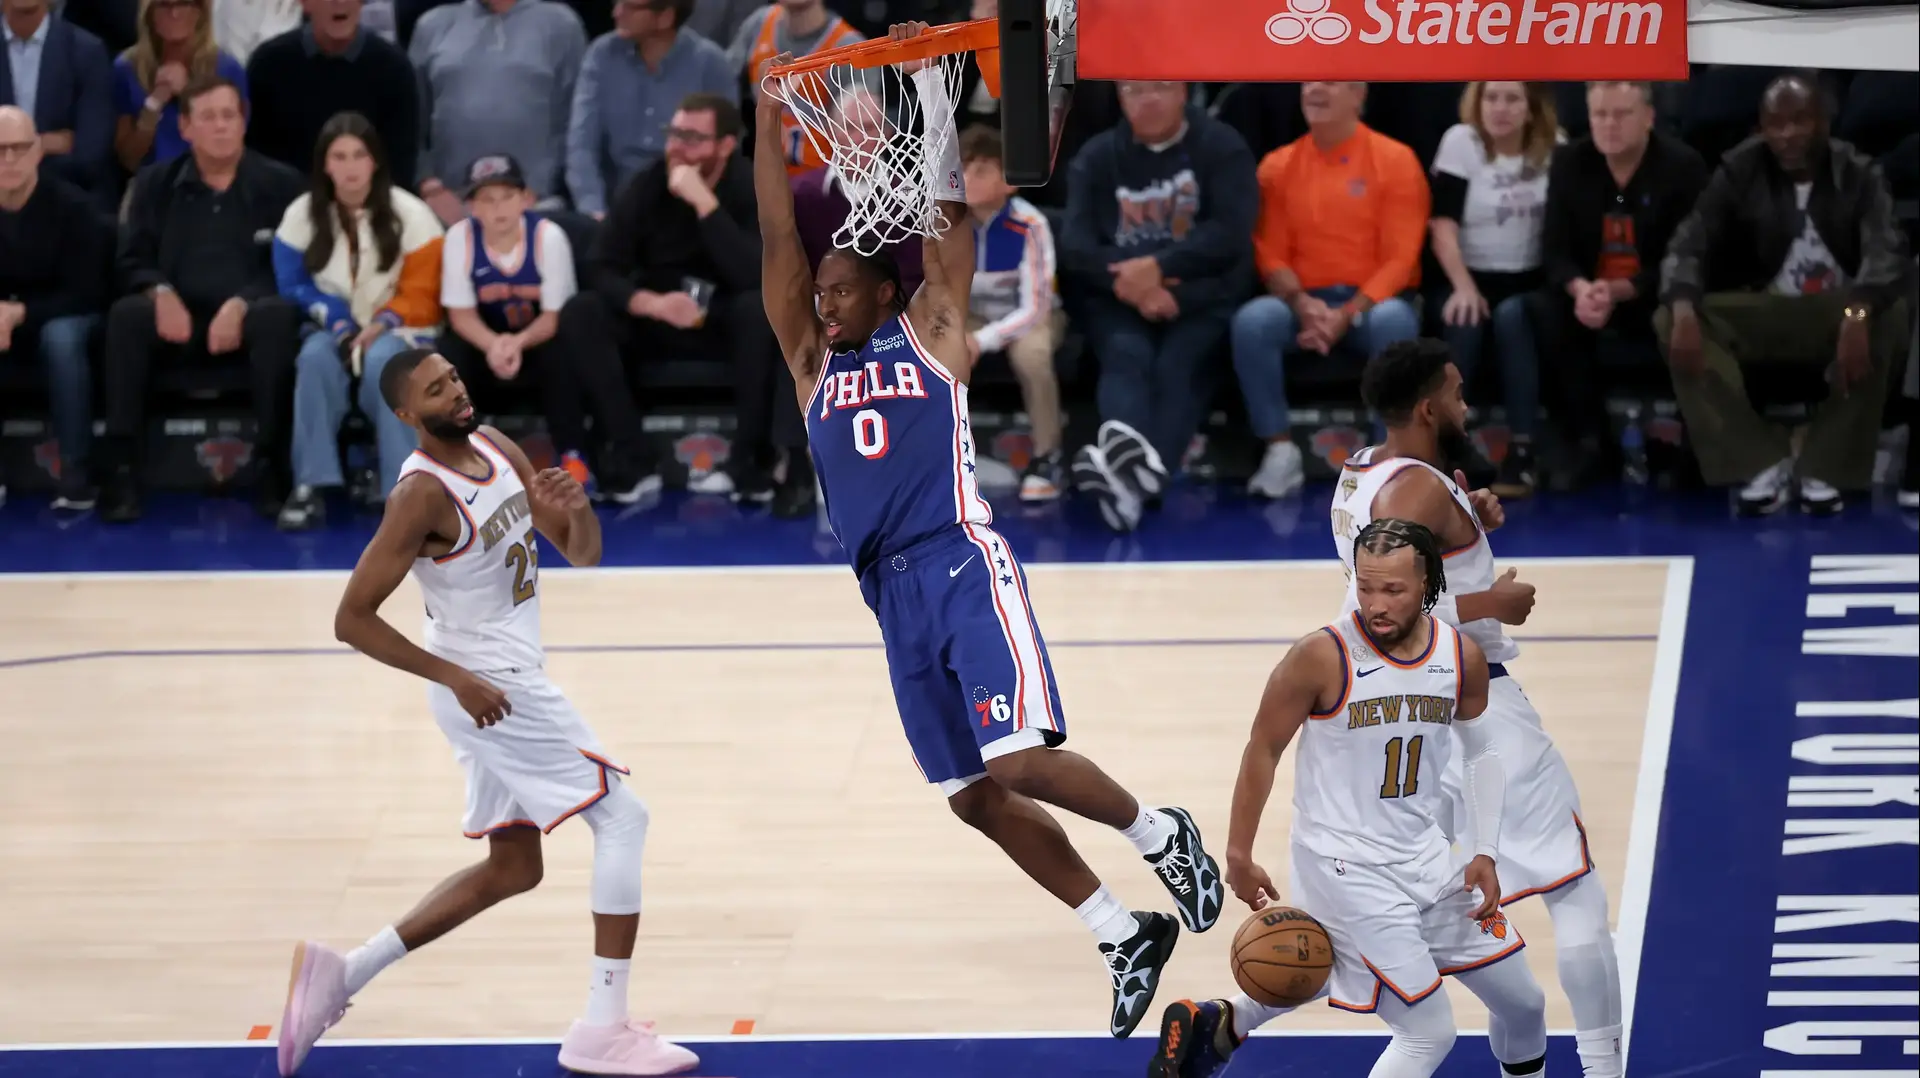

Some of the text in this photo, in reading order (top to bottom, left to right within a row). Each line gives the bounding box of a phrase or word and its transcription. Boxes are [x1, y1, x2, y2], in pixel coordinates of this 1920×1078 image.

[872, 333, 904, 347] Bloom
[873, 338, 905, 353] energy
[820, 361, 928, 421] PHILA
[852, 408, 889, 460] 0
[975, 697, 1011, 728] 76
[1348, 694, 1455, 730] NEW YORK
[1380, 735, 1423, 799] 11
